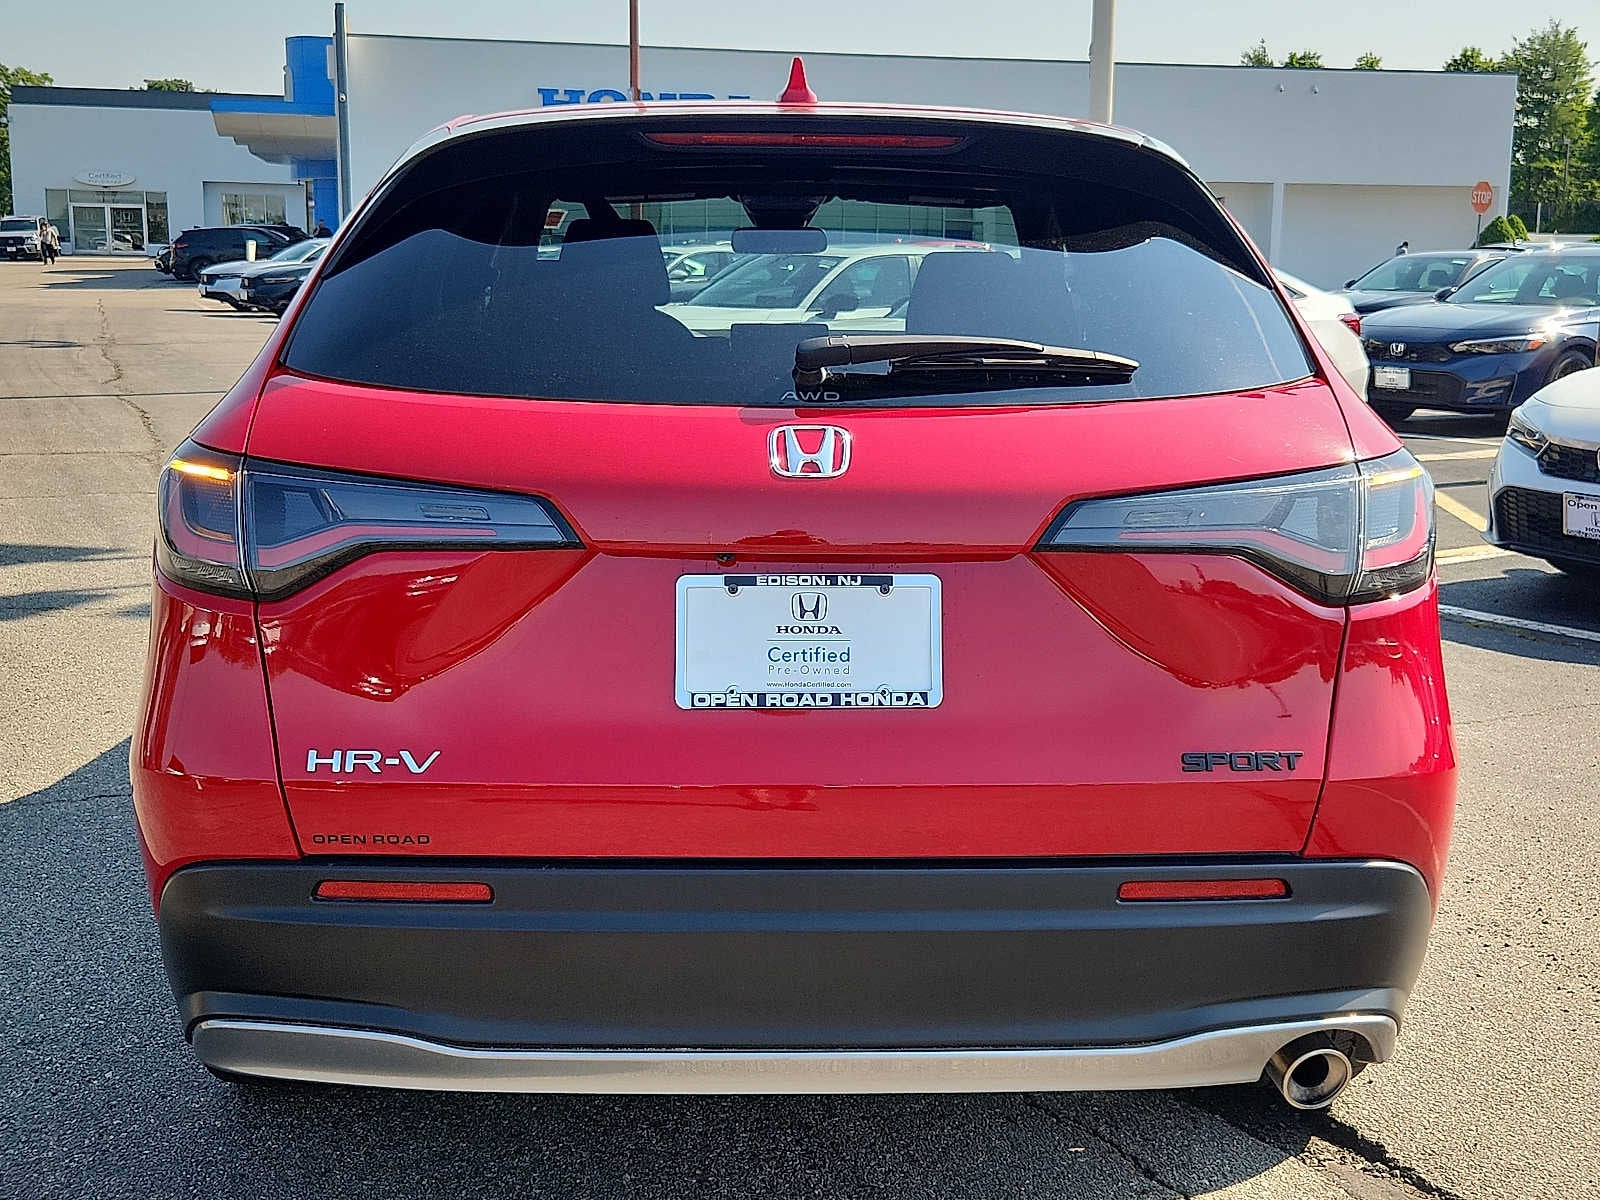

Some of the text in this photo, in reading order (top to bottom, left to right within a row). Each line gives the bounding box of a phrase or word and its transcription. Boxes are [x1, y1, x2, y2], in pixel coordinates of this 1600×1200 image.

[1472, 191, 1492, 205] STOP
[780, 391, 840, 401] AWD
[1567, 499, 1598, 510] Open
[837, 575, 862, 586] NJ
[776, 625, 842, 635] HONDA
[767, 646, 850, 663] Certified
[768, 664, 850, 675] Pre-Owned
[693, 692, 925, 707] OPEN ROAD HONDA
[306, 749, 441, 774] HR-V
[1181, 751, 1304, 772] SPORT
[312, 834, 431, 845] OPEN ROAD
